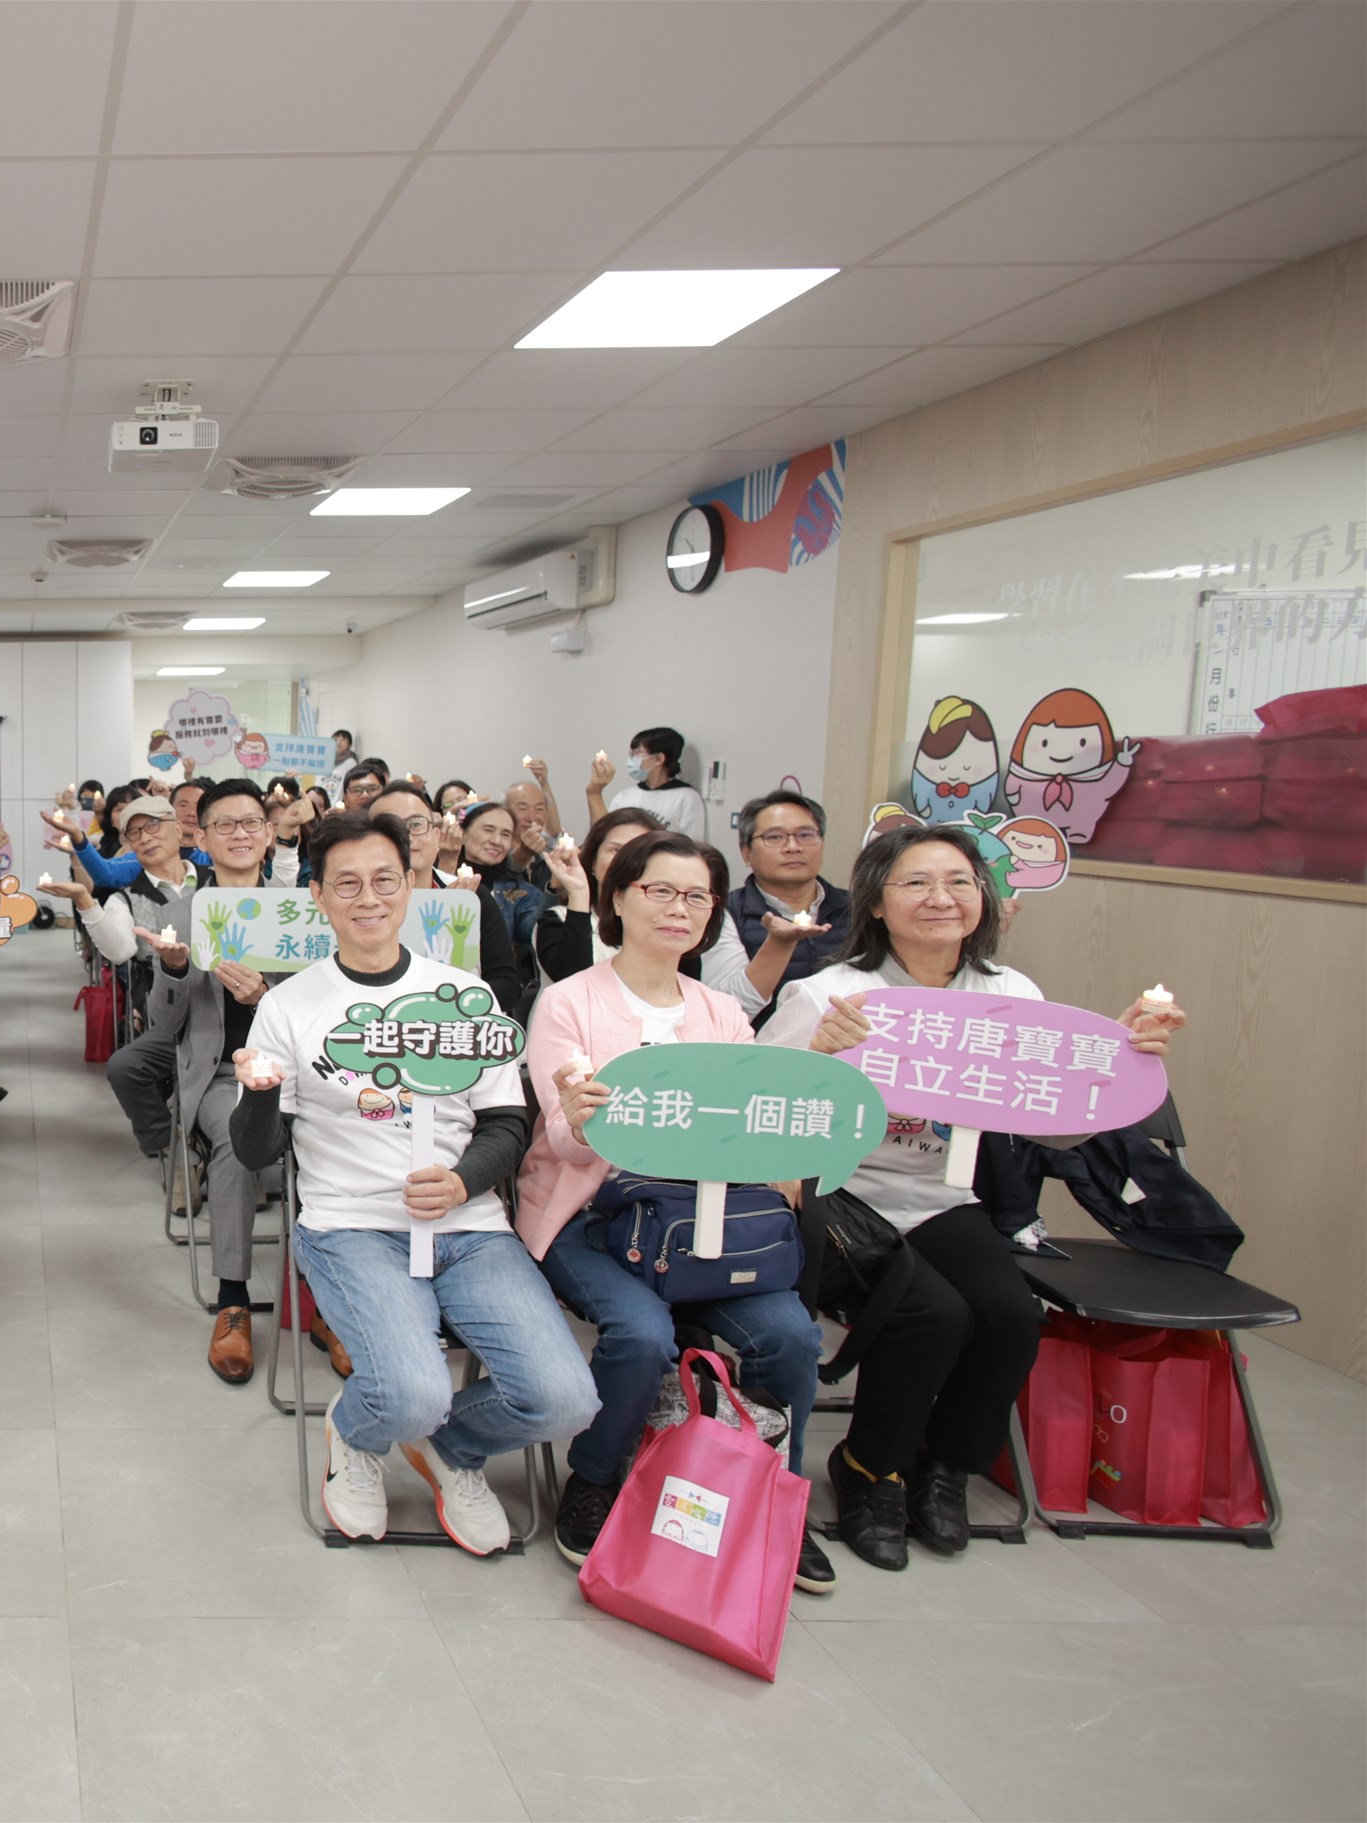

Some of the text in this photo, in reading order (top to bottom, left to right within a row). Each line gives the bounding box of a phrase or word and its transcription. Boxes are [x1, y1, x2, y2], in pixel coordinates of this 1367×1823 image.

[275, 933, 338, 960] 永續
[327, 1020, 514, 1057] 一起守護你
[861, 1003, 1121, 1077] 支持唐寶寶
